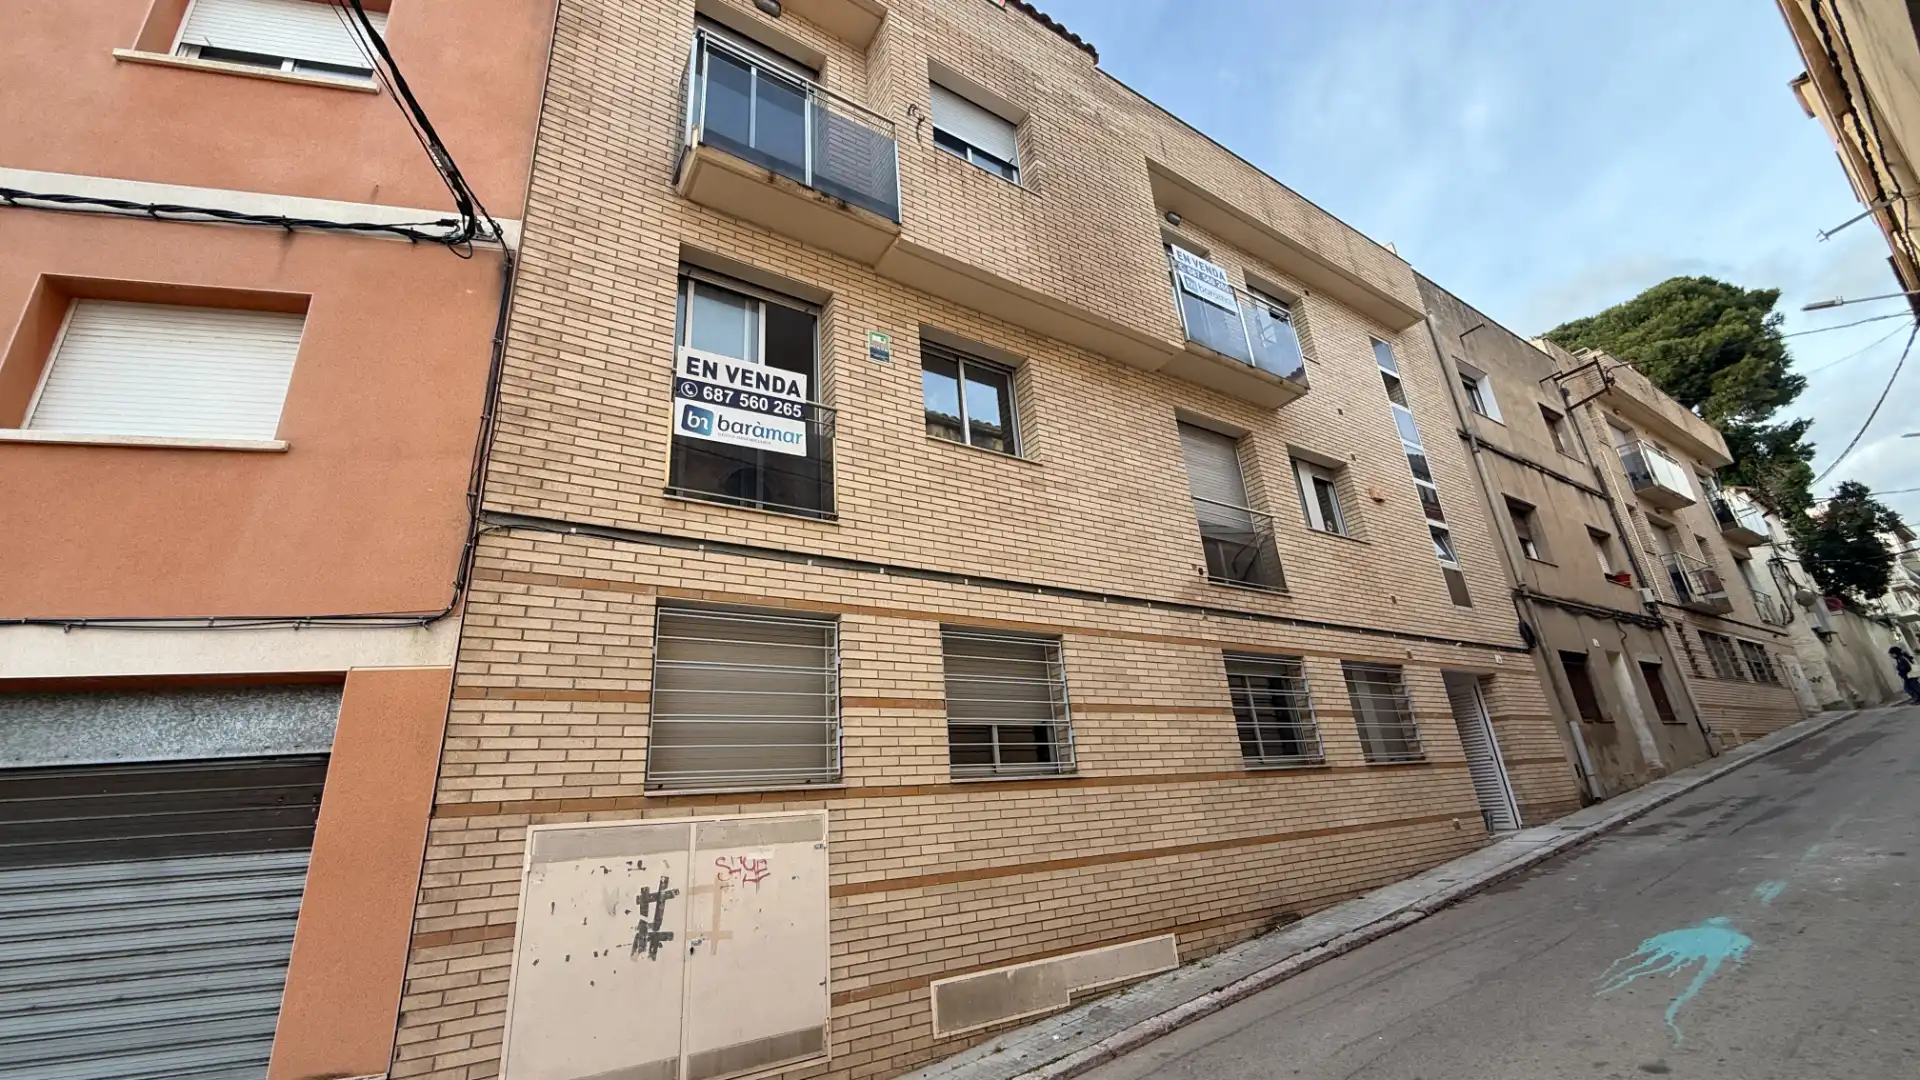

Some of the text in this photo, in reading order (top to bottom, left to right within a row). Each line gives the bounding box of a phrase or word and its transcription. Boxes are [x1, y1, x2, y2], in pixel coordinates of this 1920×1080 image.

[1176, 250, 1226, 282] EN VENDA
[686, 356, 802, 398] EN VENDA
[703, 386, 802, 418] 687 560 265
[717, 414, 803, 445] baràmar
